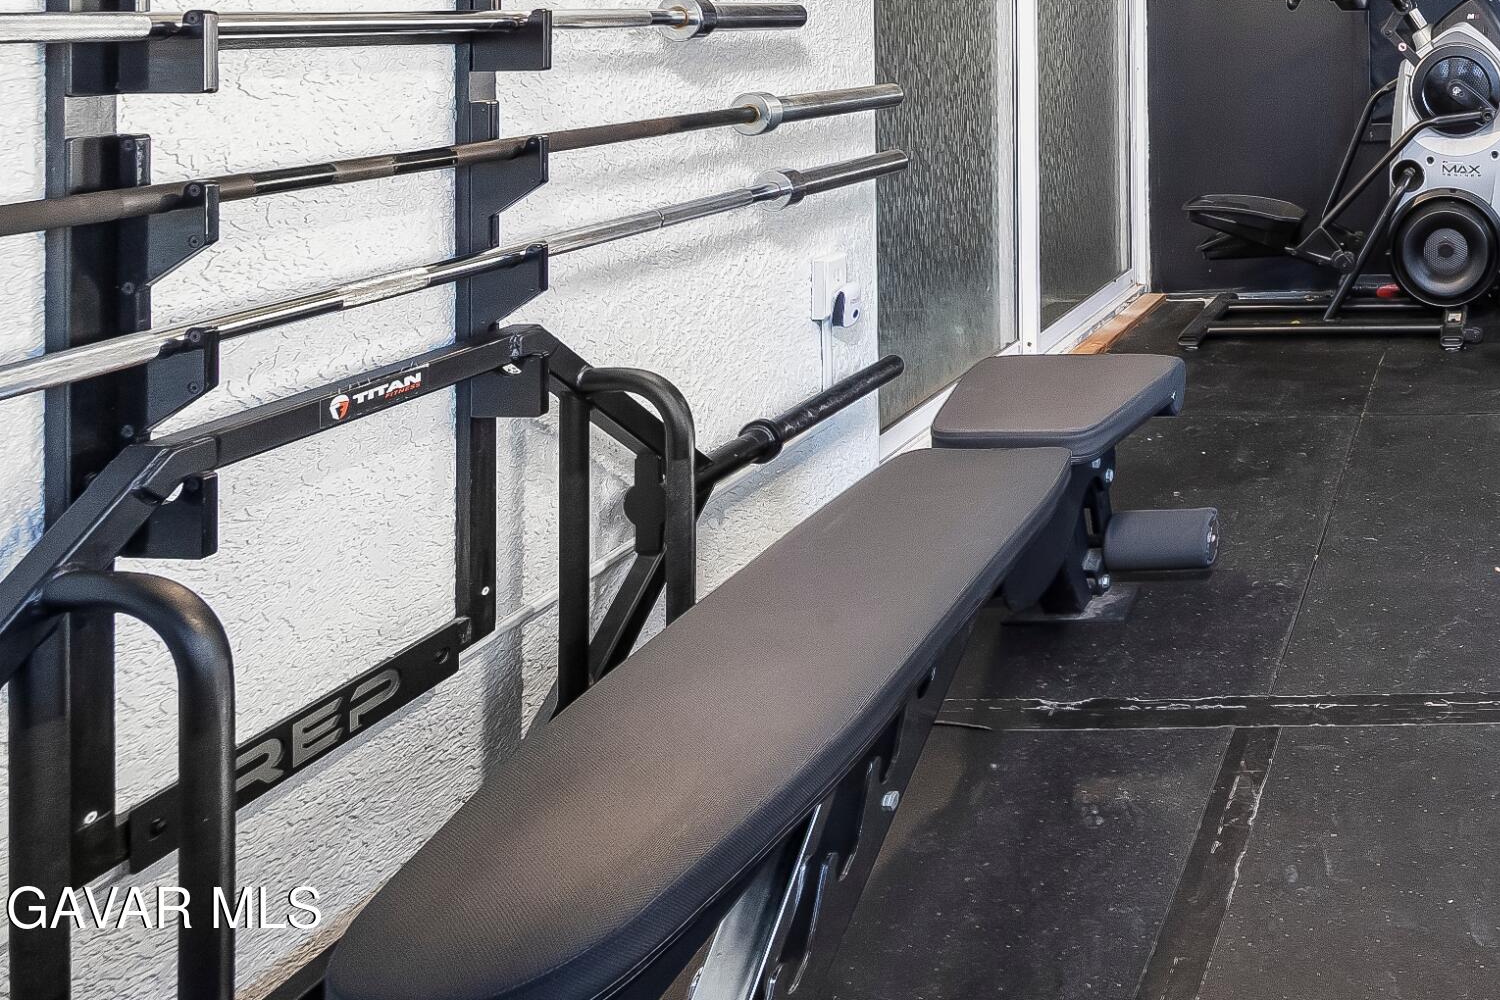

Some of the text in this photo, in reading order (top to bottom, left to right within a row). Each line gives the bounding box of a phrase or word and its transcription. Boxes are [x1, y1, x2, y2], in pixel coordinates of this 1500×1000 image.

[1442, 165, 1480, 173] MAX
[353, 372, 422, 404] TITAN
[384, 382, 421, 399] FITNESS
[236, 669, 400, 786] REP
